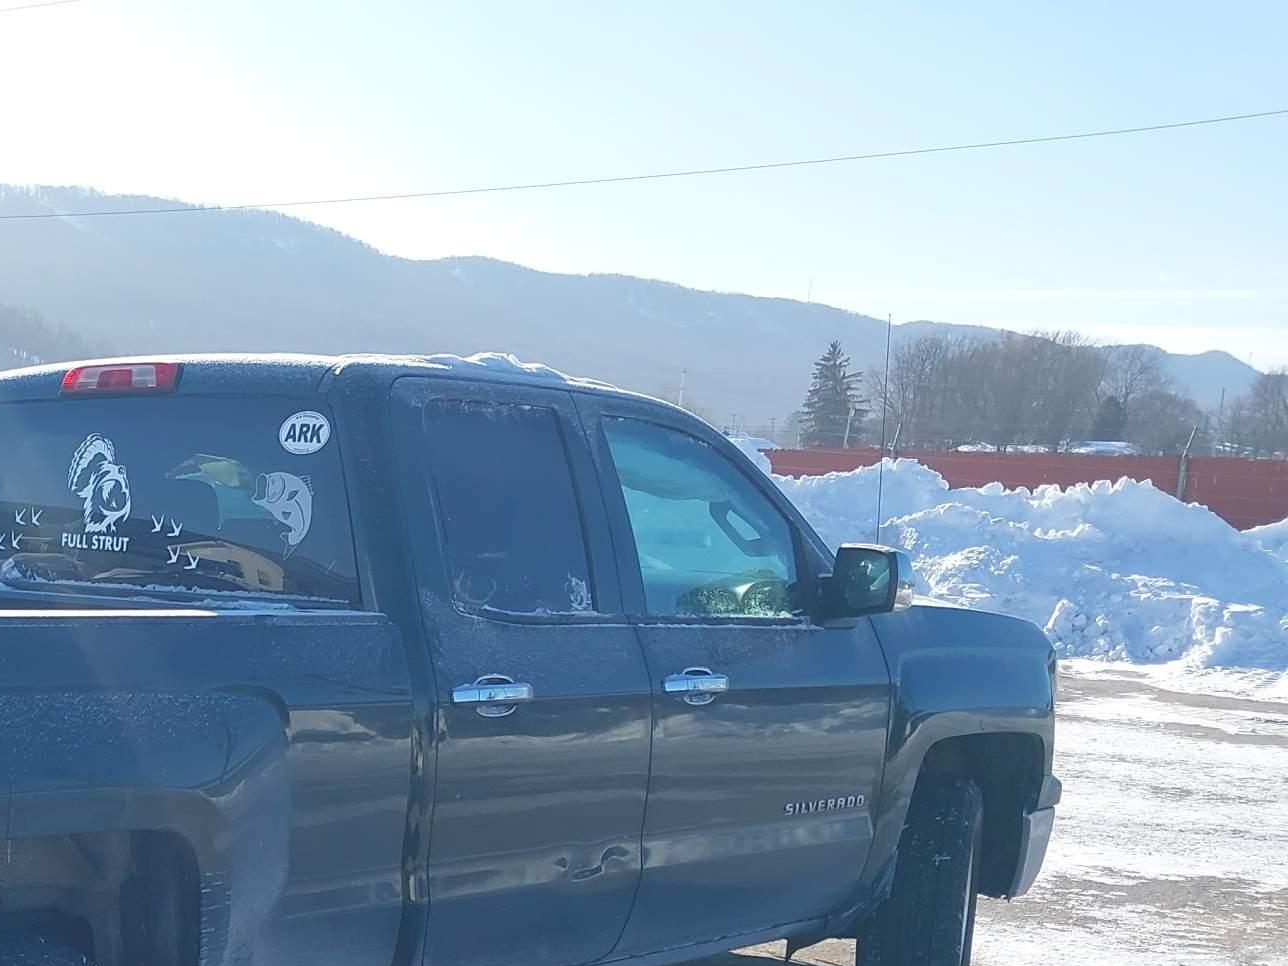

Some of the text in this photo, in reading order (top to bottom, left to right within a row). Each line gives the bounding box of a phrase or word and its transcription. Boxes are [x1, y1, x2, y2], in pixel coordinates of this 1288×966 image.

[284, 423, 325, 444] ARK
[61, 532, 130, 552] FULL STRUT
[783, 794, 865, 816] SILVERADO
